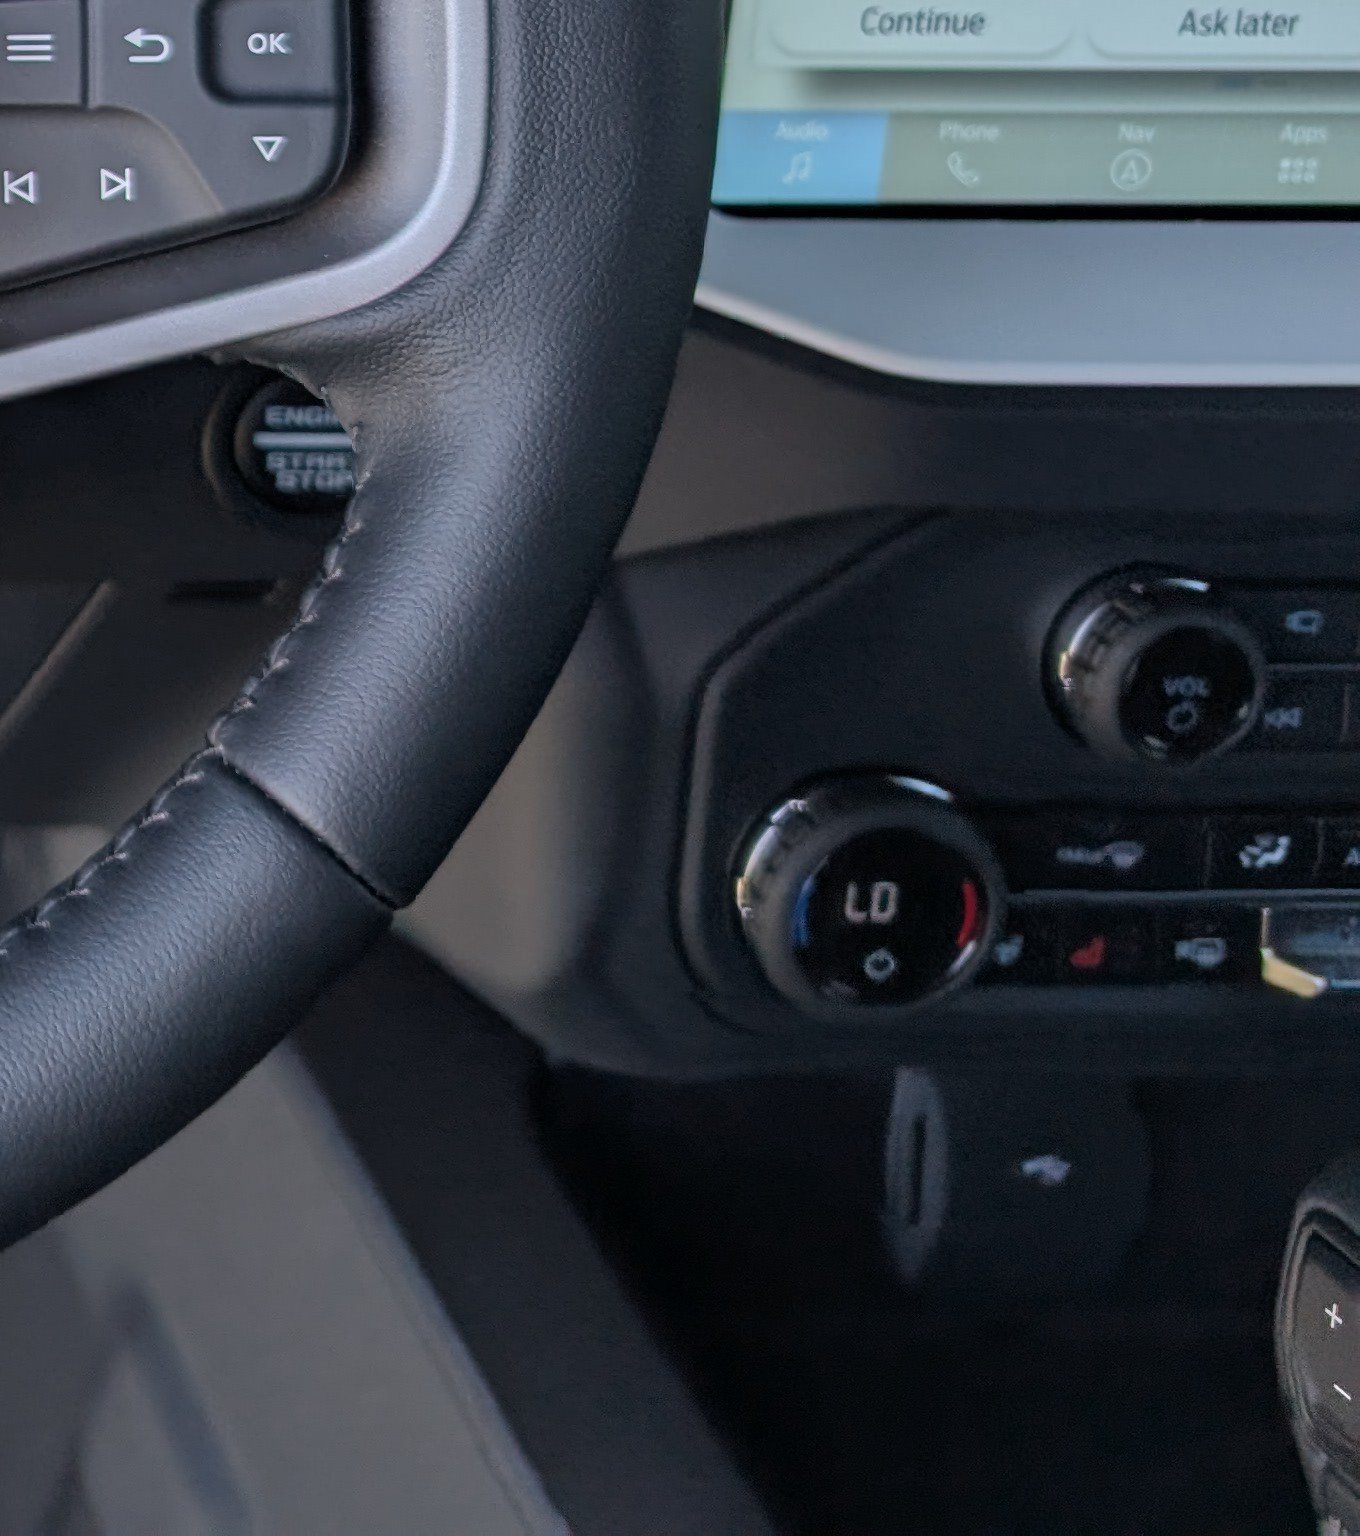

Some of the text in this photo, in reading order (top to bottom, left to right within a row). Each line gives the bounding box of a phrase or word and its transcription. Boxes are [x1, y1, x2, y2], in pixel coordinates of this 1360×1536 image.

[859, 4, 988, 39] Continue
[1178, 7, 1301, 39] Ask later
[246, 32, 289, 56] OK
[774, 120, 831, 142] Audio
[939, 120, 1002, 142] Phone
[1117, 121, 1156, 143] Nav
[1279, 122, 1329, 146] Apps
